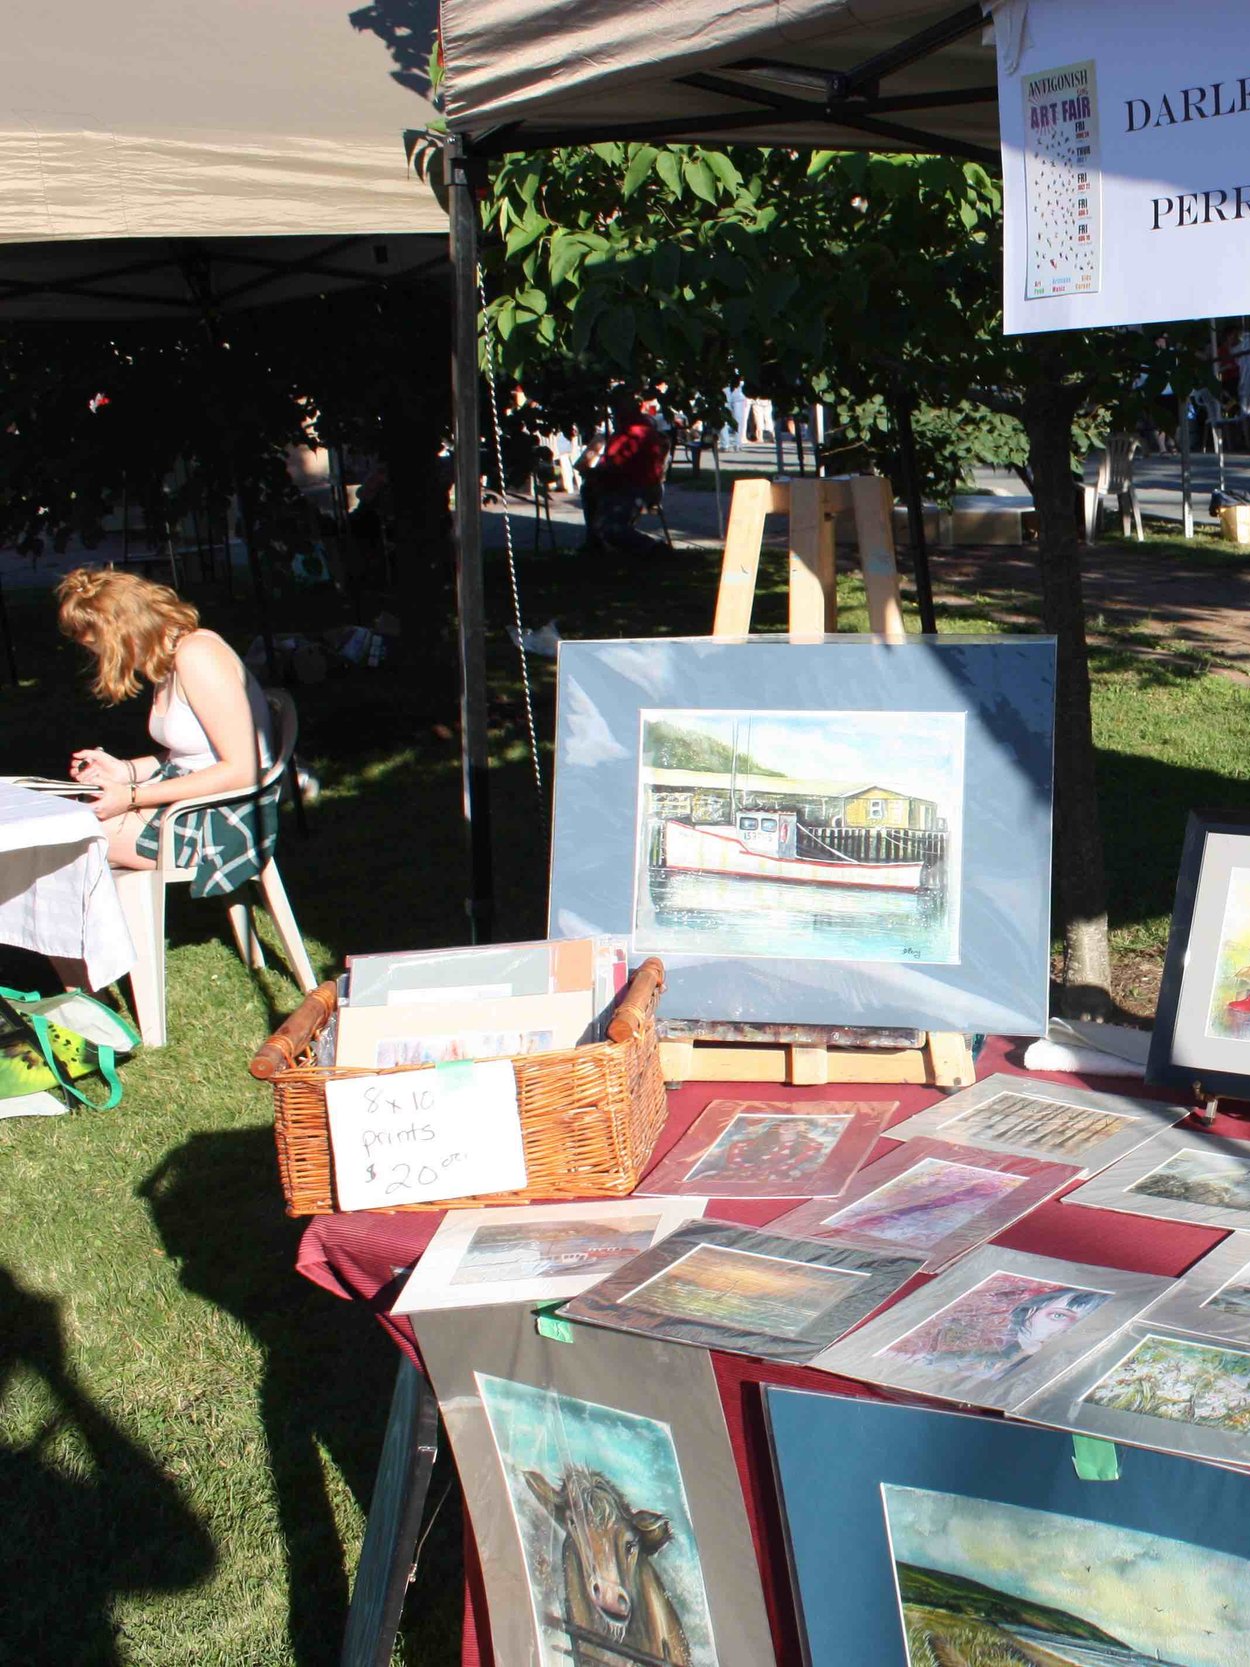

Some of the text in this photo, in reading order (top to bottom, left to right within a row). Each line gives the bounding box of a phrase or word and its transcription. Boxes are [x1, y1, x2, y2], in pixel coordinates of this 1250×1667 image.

[1028, 69, 1088, 98] ANTIGONISH
[1030, 96, 1091, 129] ART FAIR
[1076, 121, 1085, 132] FRI
[1077, 172, 1087, 184] FRI
[1078, 198, 1088, 209] FRI
[1078, 224, 1088, 235] FRI
[362, 1122, 436, 1158] prints
